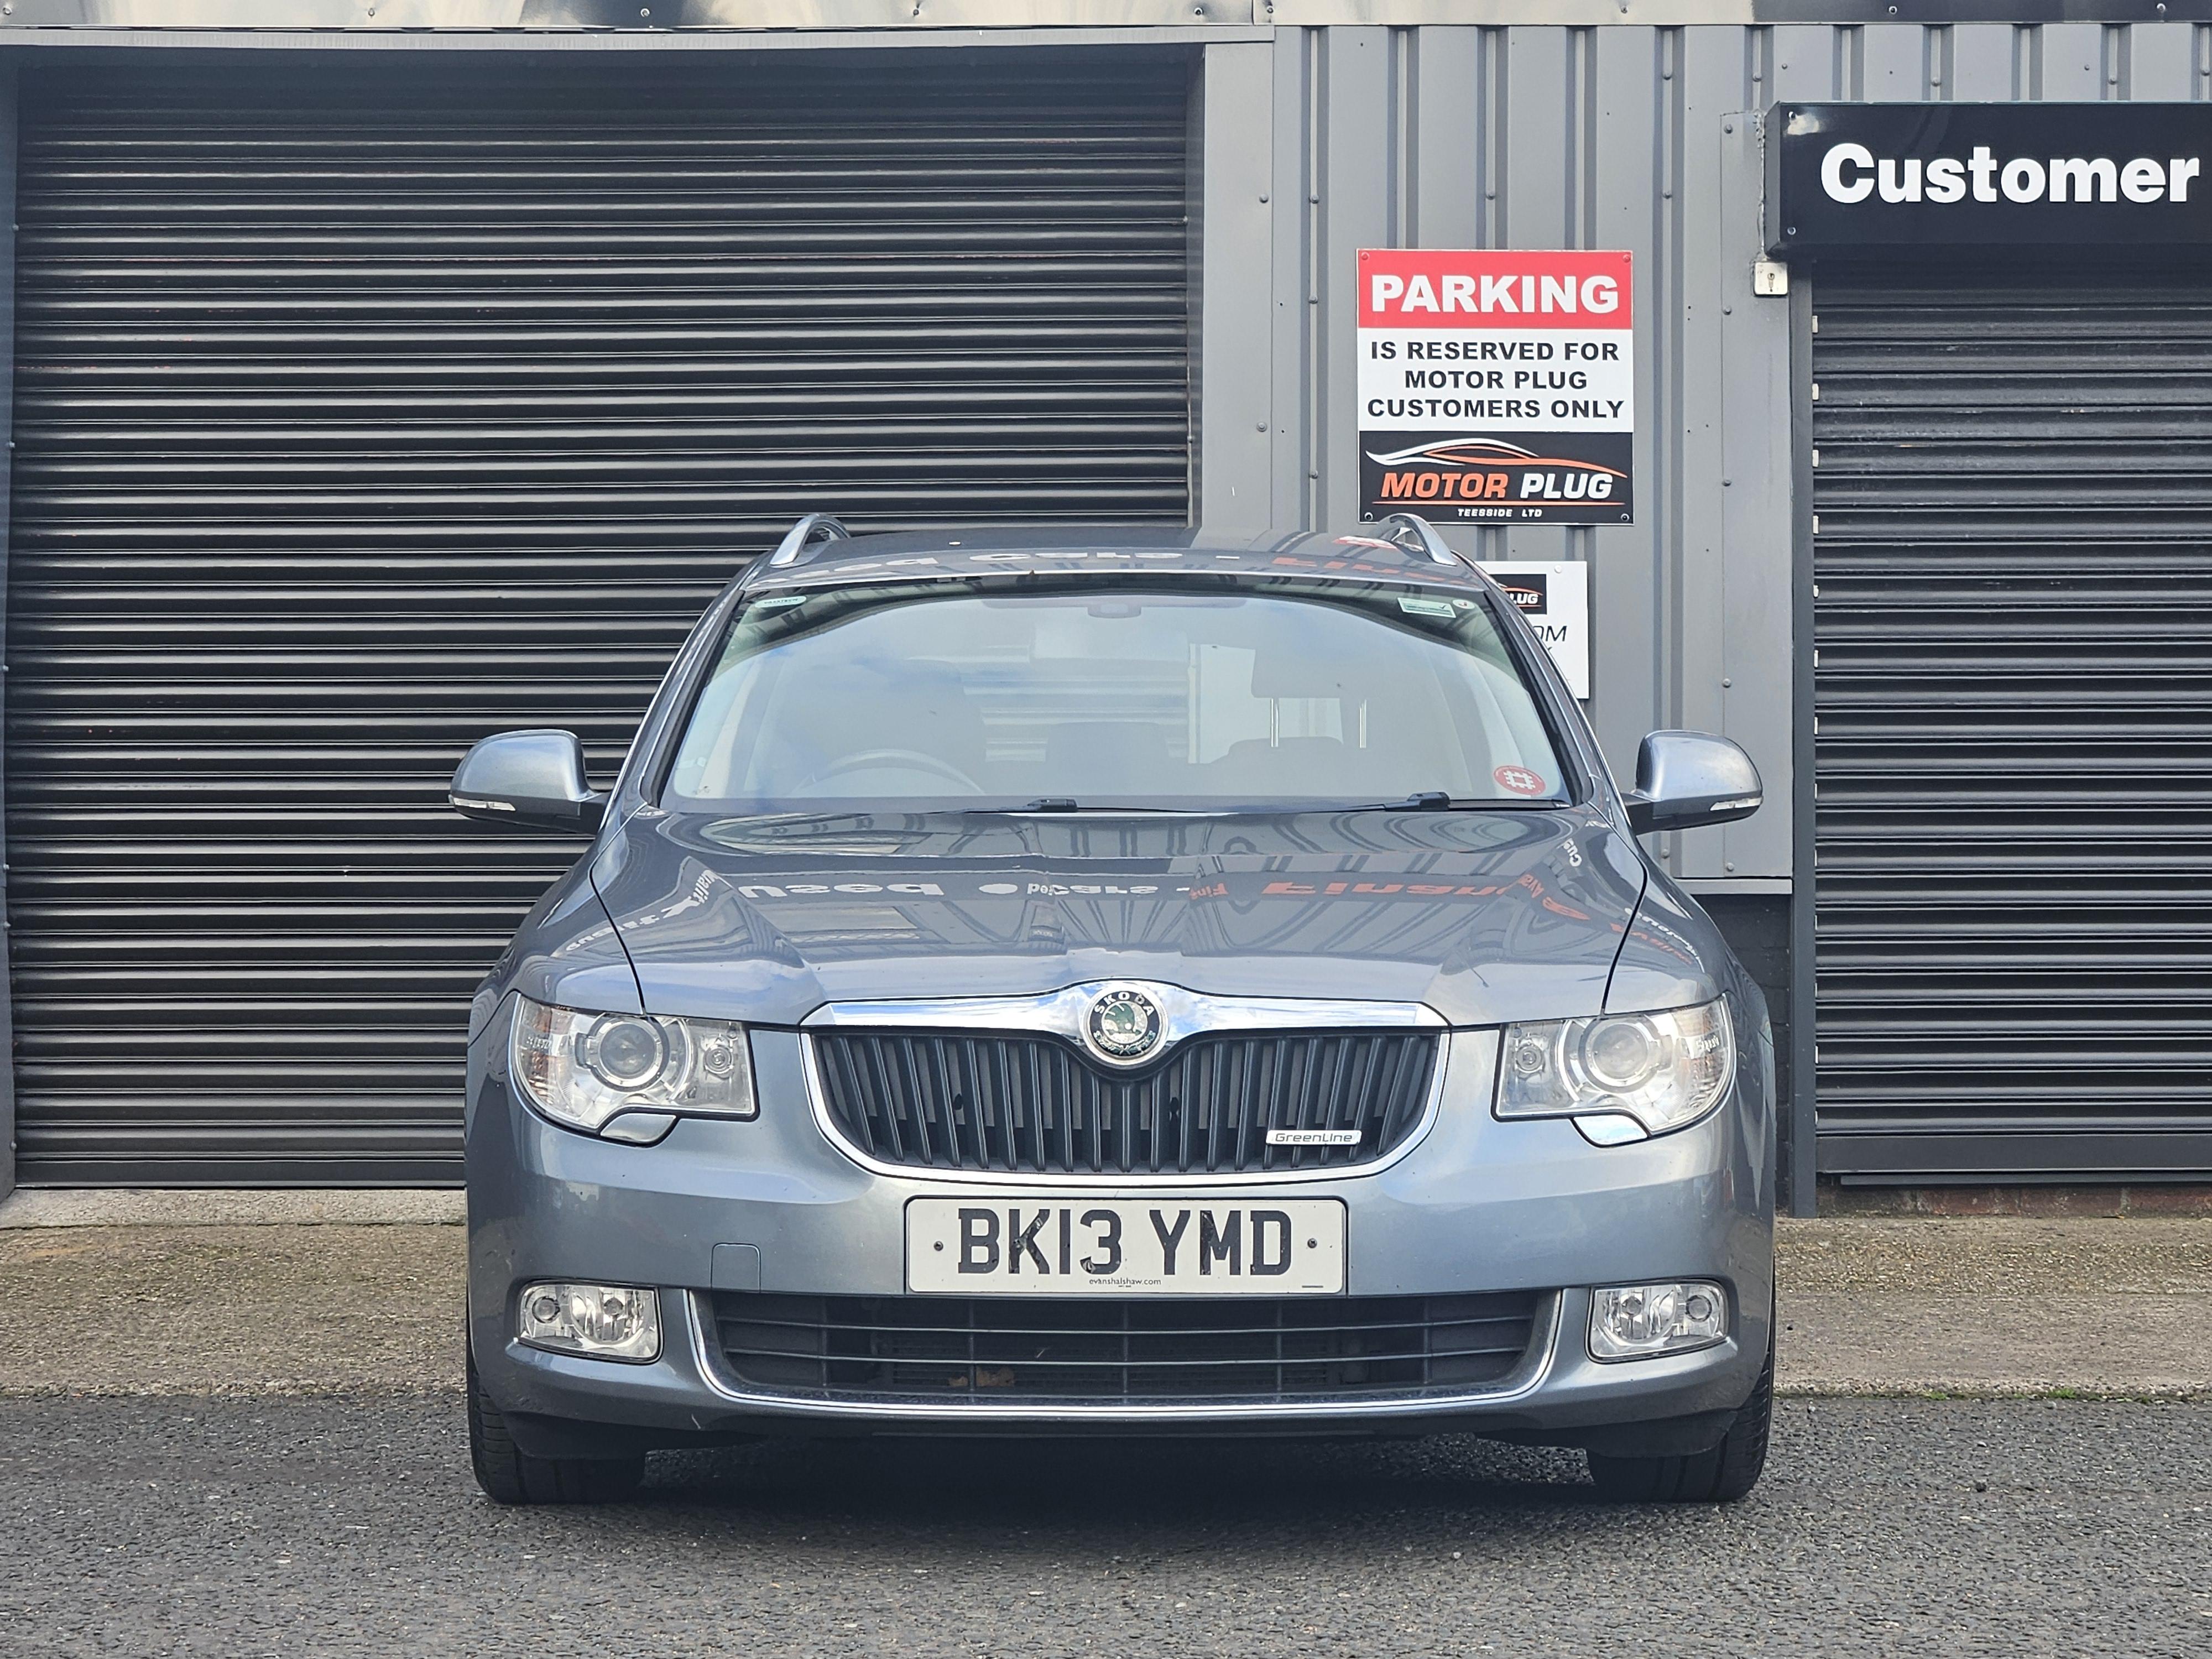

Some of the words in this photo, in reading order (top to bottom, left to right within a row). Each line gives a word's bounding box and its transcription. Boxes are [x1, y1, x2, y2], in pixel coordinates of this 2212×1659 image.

[1821, 143, 2200, 204] Customer
[1372, 275, 1619, 314] PARKING
[1371, 341, 1396, 359] IS
[1407, 342, 1553, 360] RESERVED
[1564, 342, 1619, 361] FOR
[1405, 371, 1504, 389] MOTOR
[1514, 371, 1587, 389] PLUG
[1368, 399, 1540, 418] CUSTOMERS
[1551, 400, 1625, 418] ONLY
[1380, 472, 1509, 498] MOTOR
[1520, 473, 1613, 499] PLUG
[1458, 508, 1513, 518] TEESSIDE
[1521, 509, 1543, 518] LTD
[1510, 593, 1539, 604] LUG
[1275, 1133, 1353, 1142] GreenLine
[958, 1208, 1121, 1275] BK13
[1149, 1209, 1292, 1276] YMD
